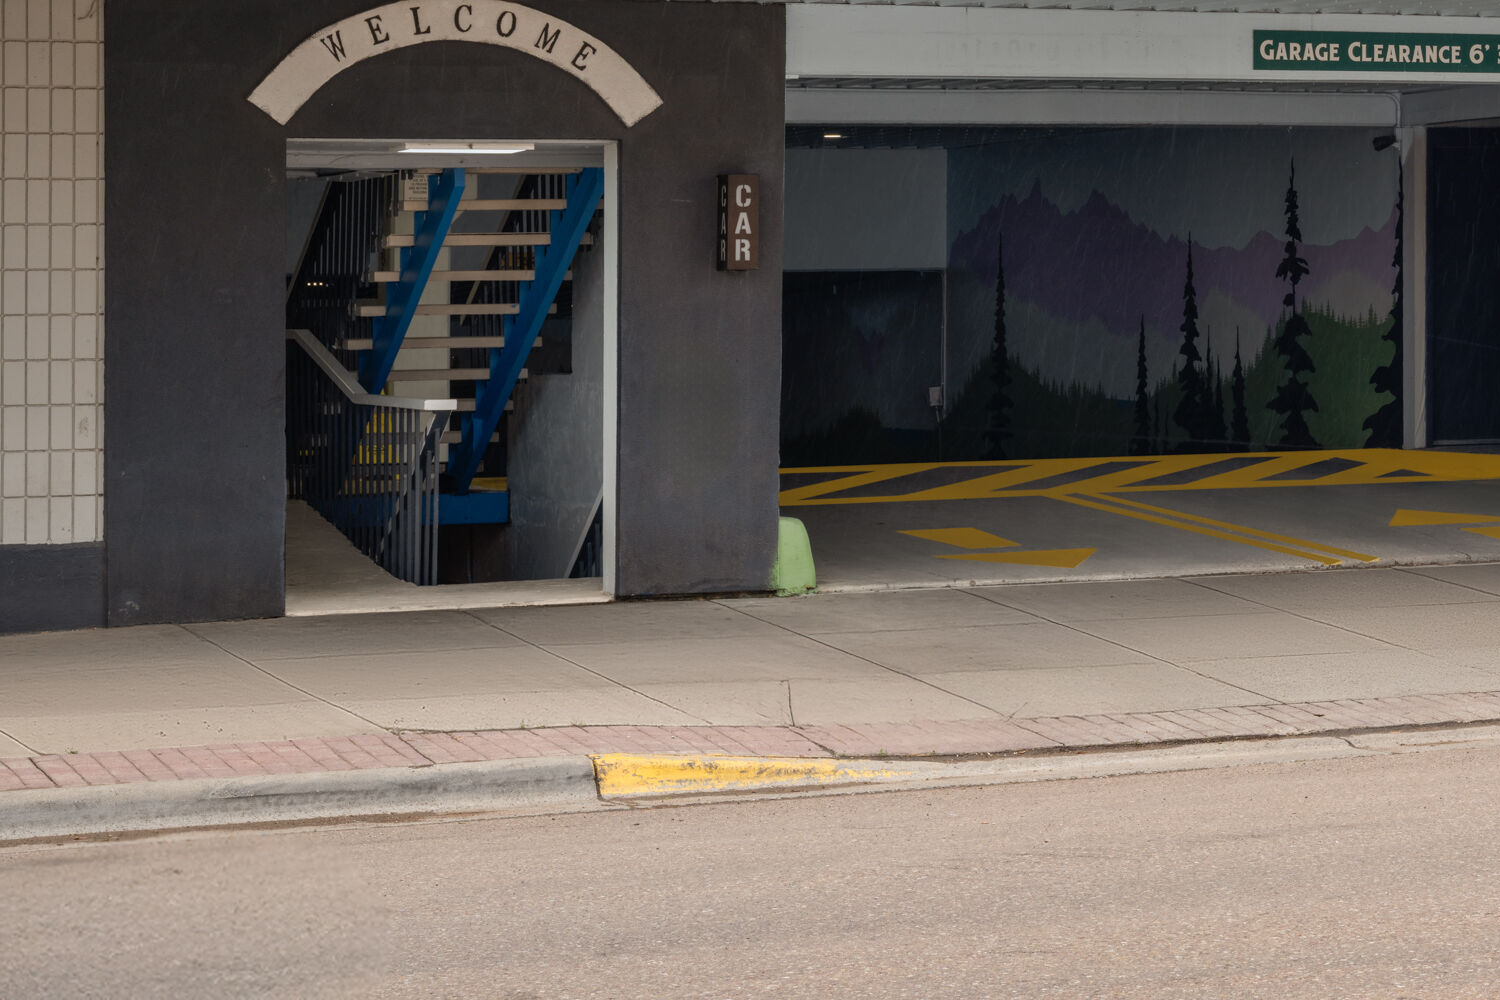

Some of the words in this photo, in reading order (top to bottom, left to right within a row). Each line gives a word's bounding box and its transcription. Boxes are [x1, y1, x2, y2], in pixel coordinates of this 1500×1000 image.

[320, 4, 597, 72] WELCOME
[1259, 39, 1340, 62] GARAGE
[1348, 41, 1462, 64] CLEARANCE
[735, 184, 752, 261] CAR
